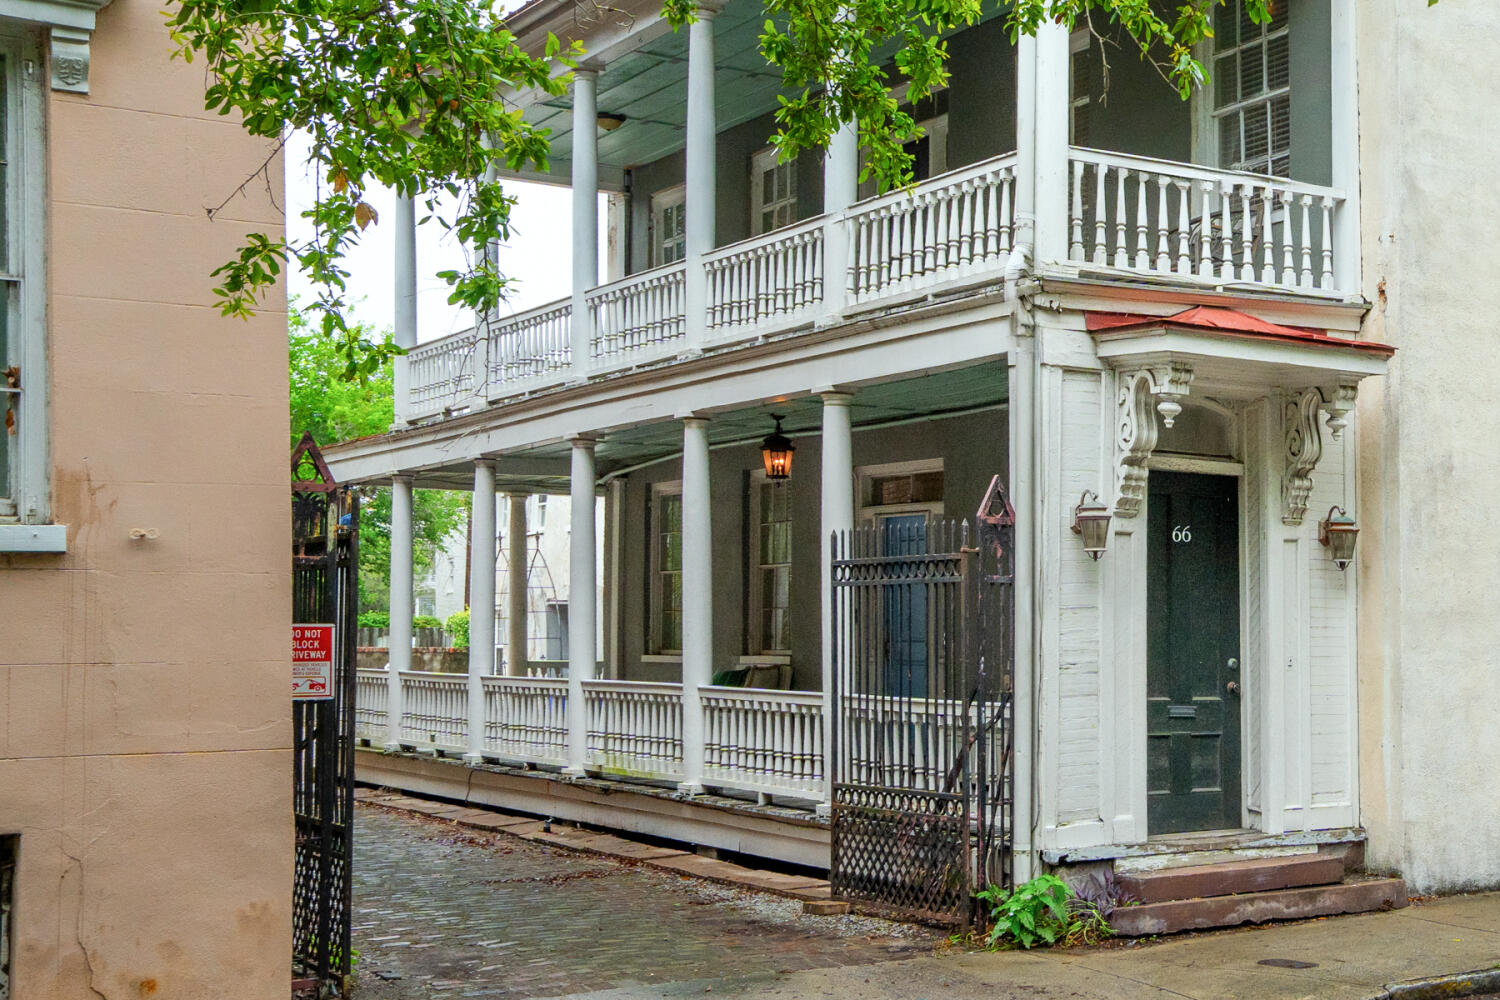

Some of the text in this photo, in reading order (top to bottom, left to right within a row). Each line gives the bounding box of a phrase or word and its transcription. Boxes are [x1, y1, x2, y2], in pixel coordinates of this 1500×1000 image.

[1172, 525, 1191, 542] 66
[304, 630, 322, 638] NOT
[291, 640, 320, 648] BLOCK
[291, 651, 326, 659] RIVEWAY
